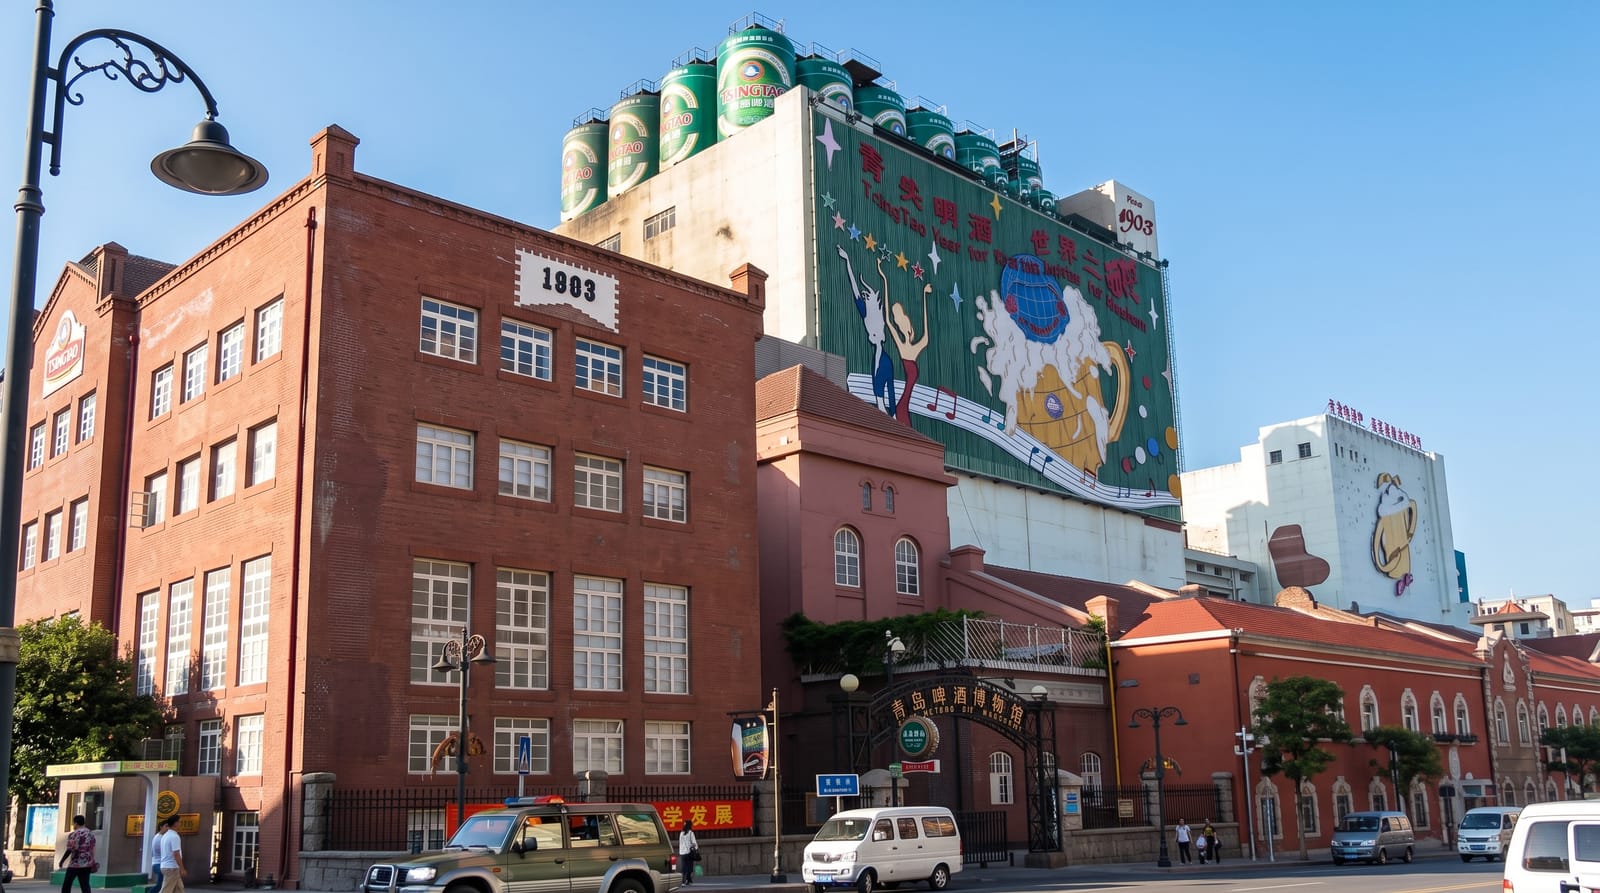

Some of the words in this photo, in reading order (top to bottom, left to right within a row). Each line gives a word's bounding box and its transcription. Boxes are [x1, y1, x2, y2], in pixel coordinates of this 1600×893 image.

[1118, 209, 1154, 236] 1903
[542, 267, 596, 302] 1903
[891, 686, 1024, 725] 青岛啤酒博物馆
[663, 804, 733, 827] 学发展
